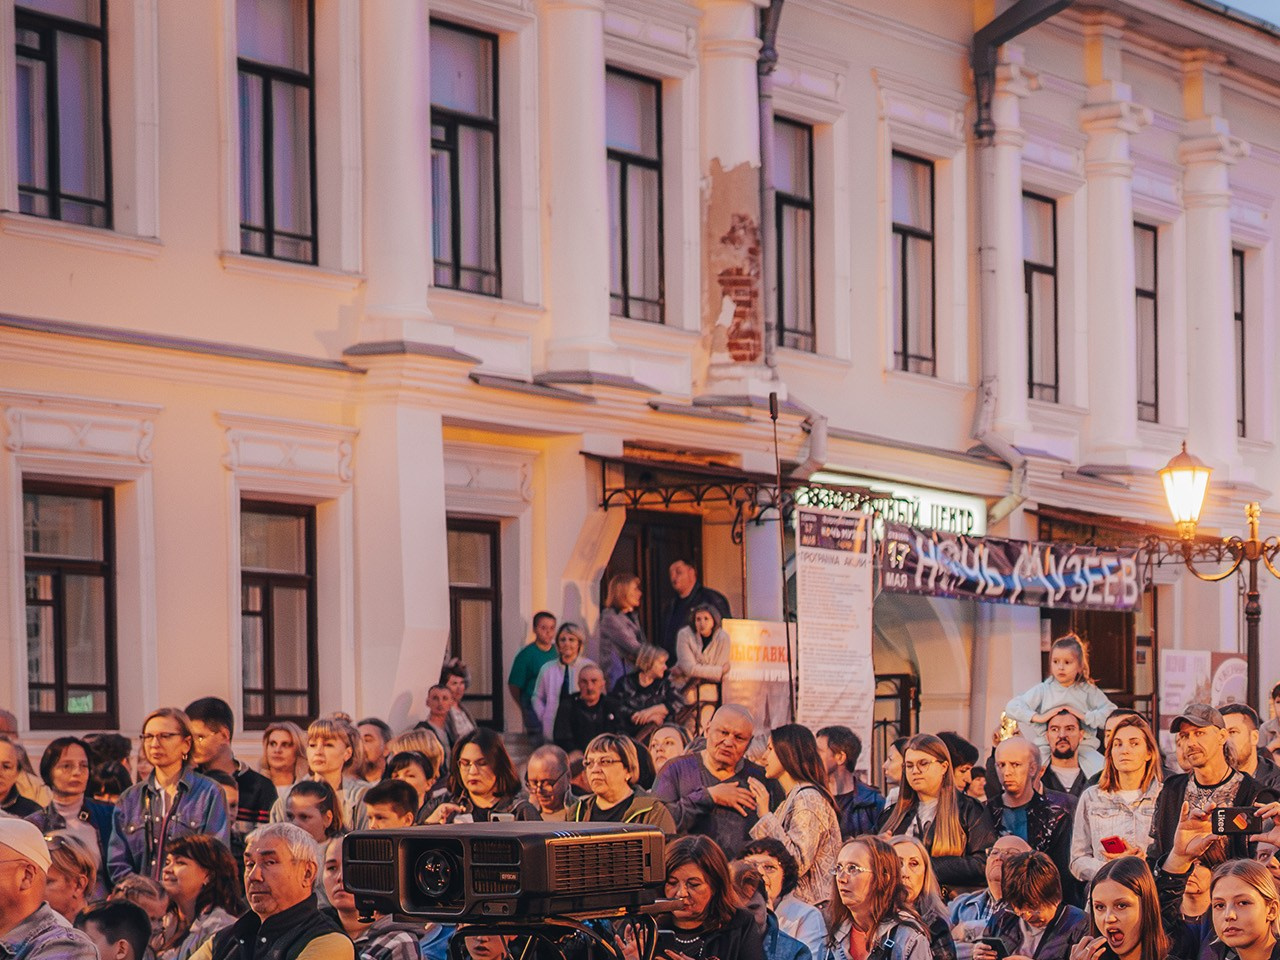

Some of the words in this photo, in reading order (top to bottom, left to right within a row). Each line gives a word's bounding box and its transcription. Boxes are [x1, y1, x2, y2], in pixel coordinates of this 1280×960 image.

[887, 541, 910, 569] 17
[885, 572, 908, 588] МАЯ
[1010, 543, 1139, 607] МУЗЕЕВ
